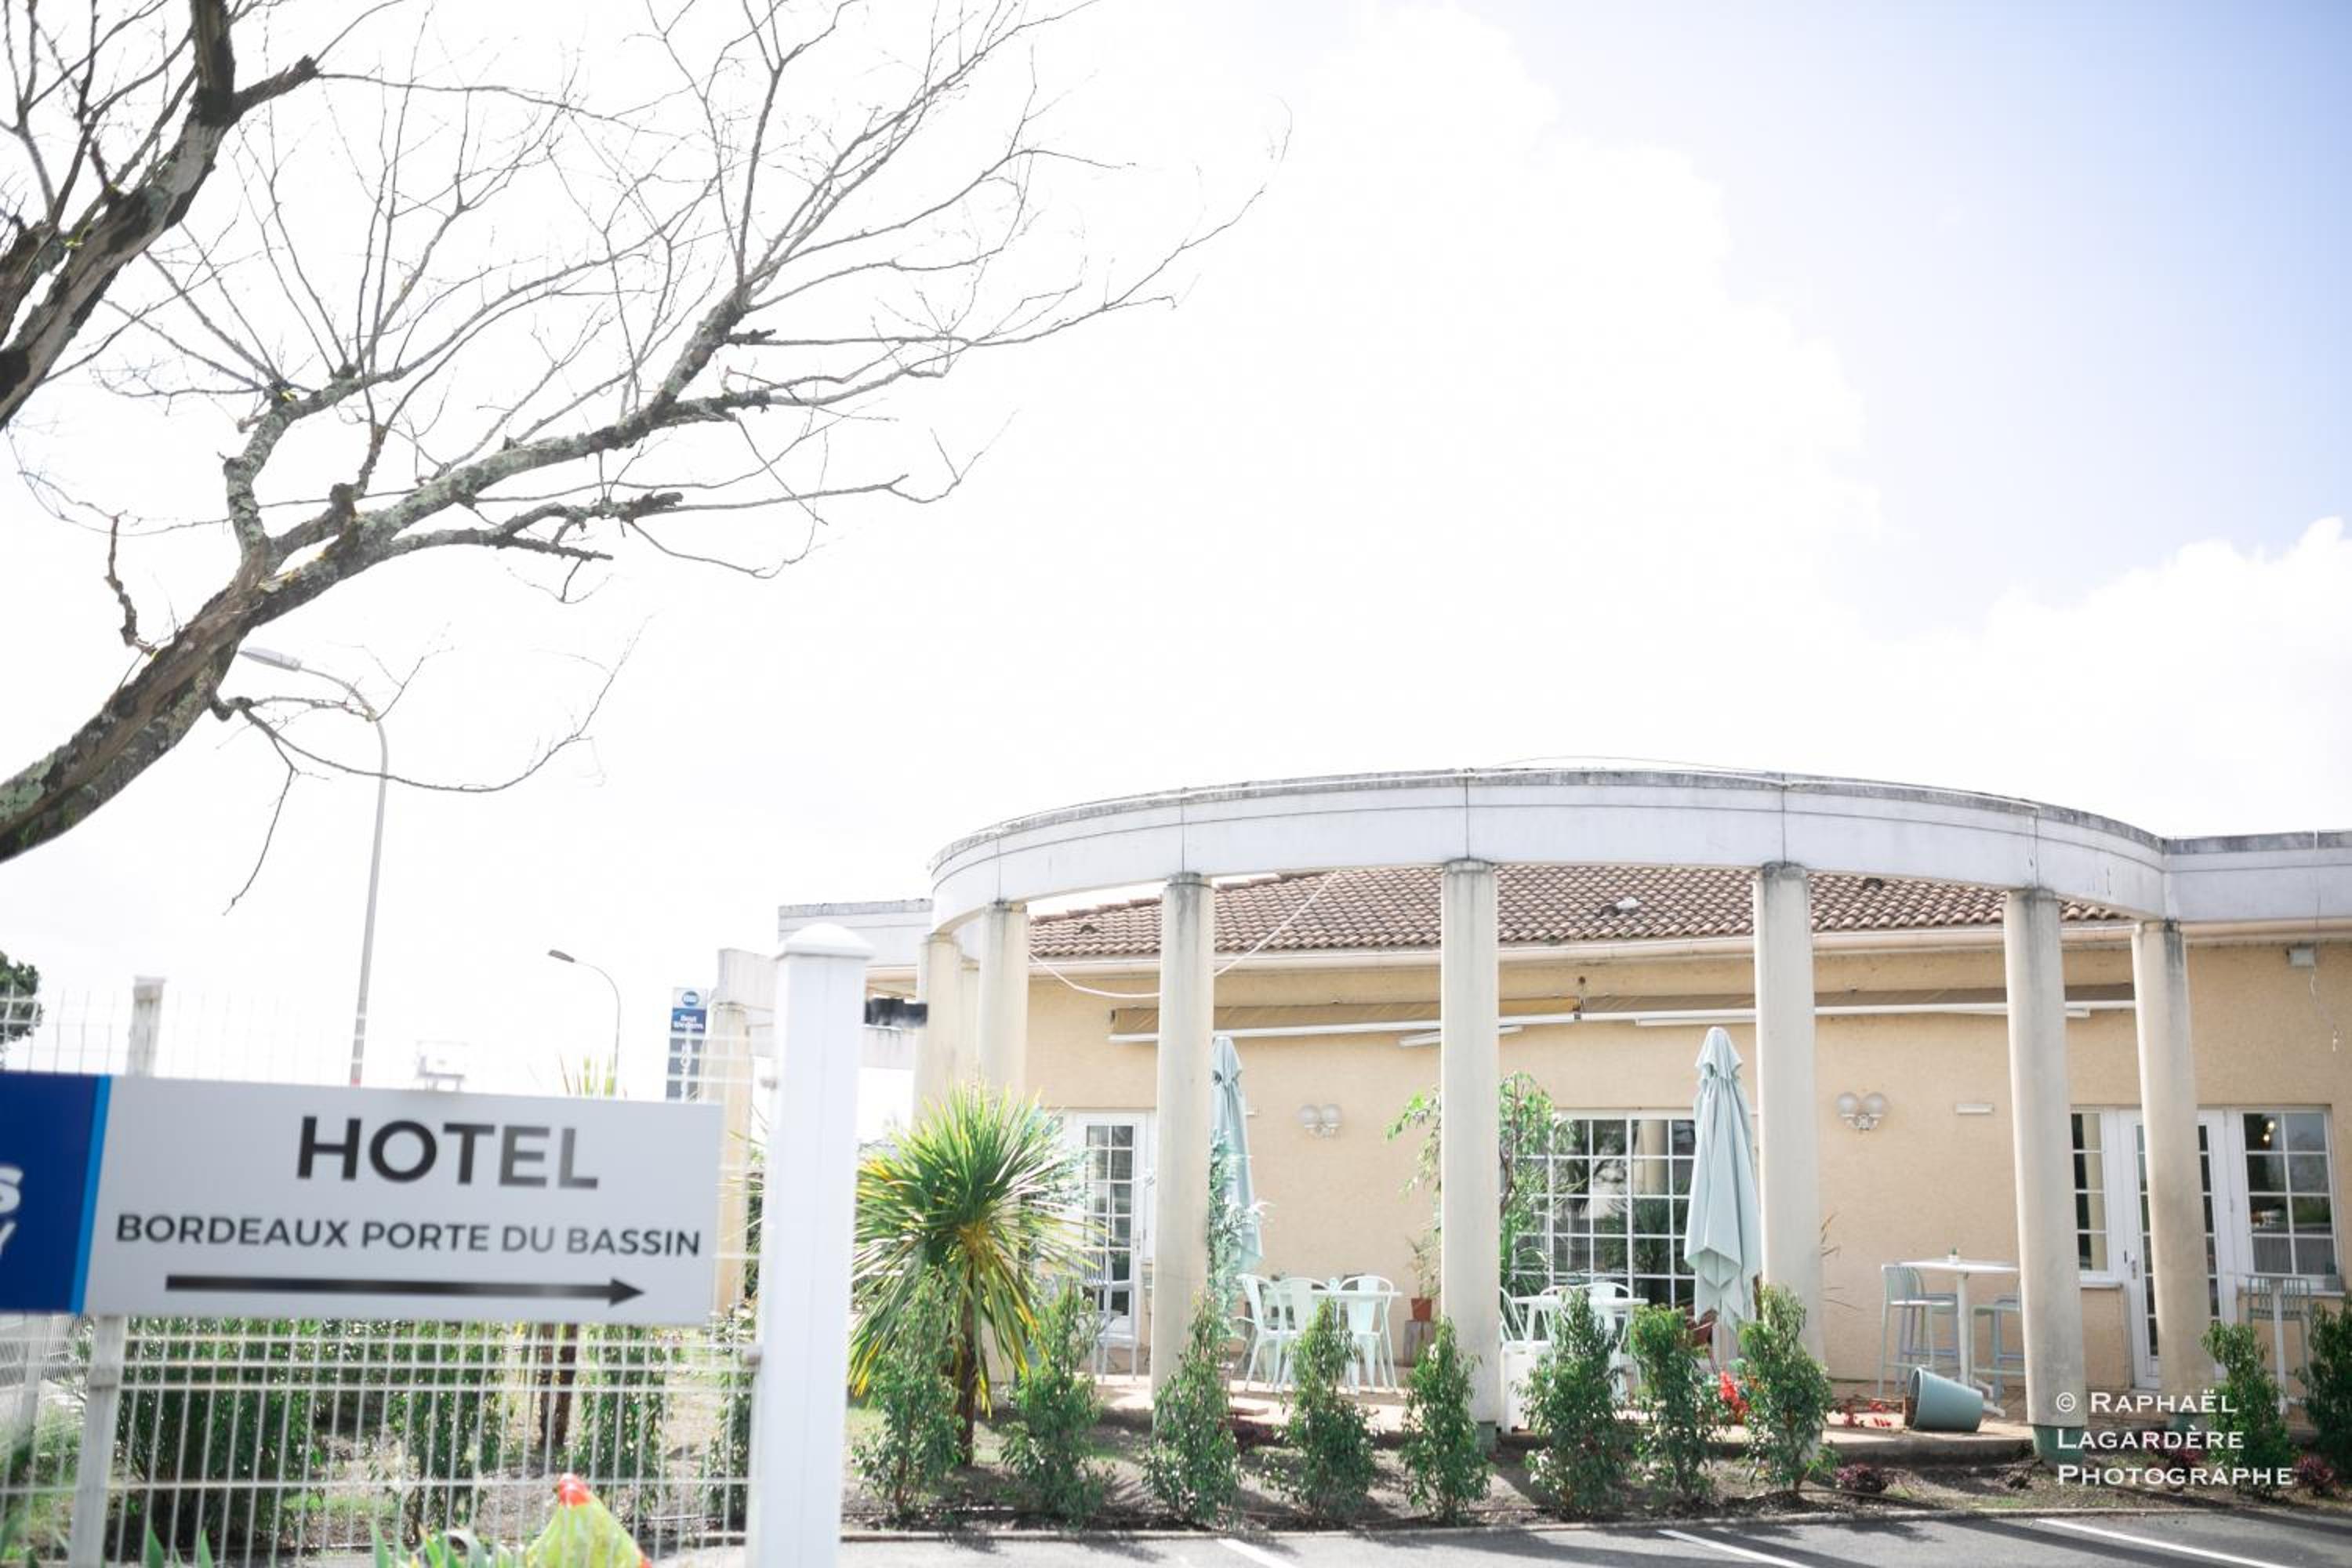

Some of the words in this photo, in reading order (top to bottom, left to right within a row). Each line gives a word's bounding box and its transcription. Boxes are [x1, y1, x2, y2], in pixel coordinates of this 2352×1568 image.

[297, 1116, 599, 1189] HOTEL
[116, 1214, 350, 1248] BORDEAUX
[361, 1221, 490, 1251] PORTE
[502, 1225, 555, 1254] DU
[566, 1227, 701, 1258] BASSIN
